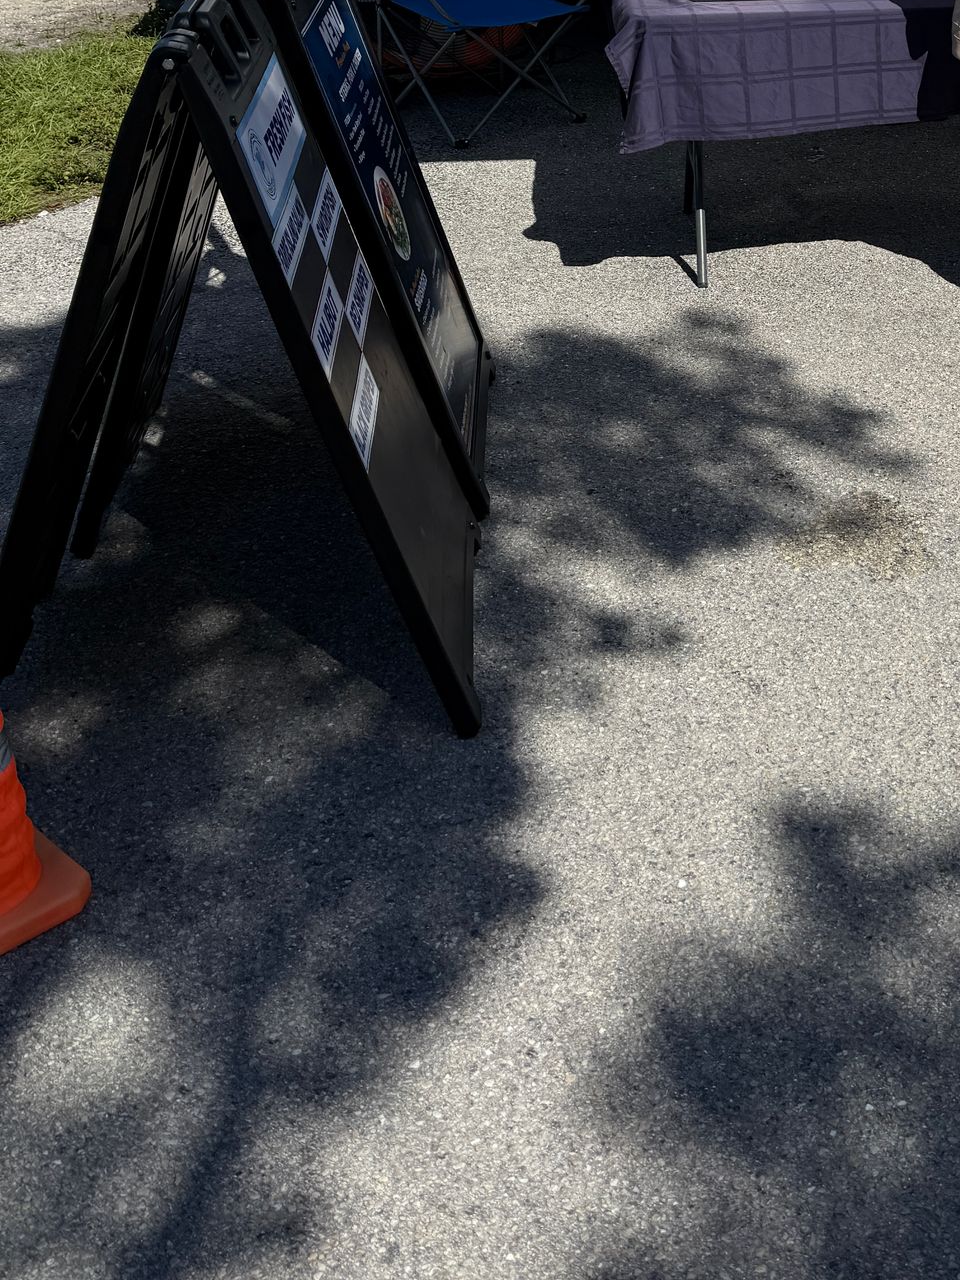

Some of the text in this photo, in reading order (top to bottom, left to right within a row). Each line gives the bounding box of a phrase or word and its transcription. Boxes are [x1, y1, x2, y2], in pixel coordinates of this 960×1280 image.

[319, 1, 344, 55] MENU
[263, 109, 287, 165] FRESH
[277, 87, 294, 132] FISH
[317, 286, 337, 359] HALIBUT
